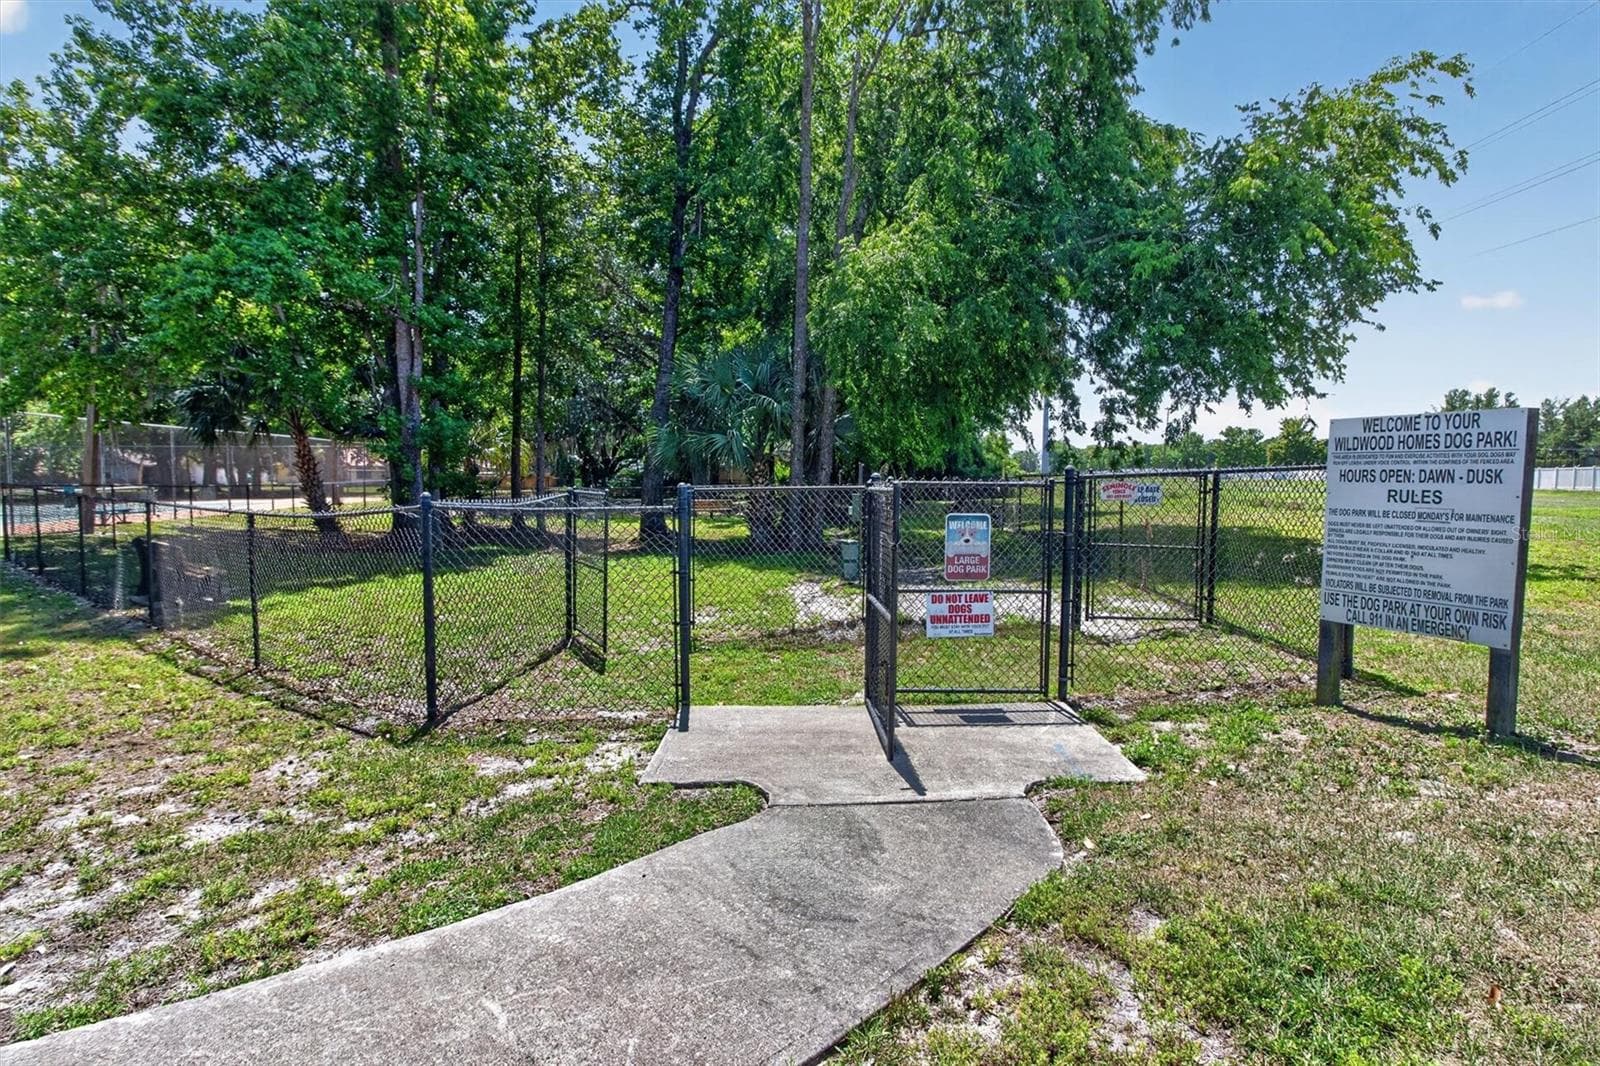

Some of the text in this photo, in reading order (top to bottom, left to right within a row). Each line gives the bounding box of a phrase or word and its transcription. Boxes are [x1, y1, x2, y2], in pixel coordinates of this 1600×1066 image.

[1362, 413, 1480, 432] WELCOME TO YOUR
[1334, 431, 1517, 450] WILDWOOD HOMES DOG PARK!
[1339, 470, 1376, 482] HOURS
[1380, 470, 1415, 482] OPEN:
[1419, 470, 1455, 483] DAWN
[1467, 470, 1503, 484] DUSK
[1388, 490, 1442, 504] RULES
[948, 520, 988, 530] WELCOME
[1465, 513, 1515, 523] MAINTENANCE
[954, 556, 980, 564] LARGE
[948, 565, 987, 574] DOG PARK
[932, 594, 989, 604] DO NOT LEAVE
[1326, 579, 1508, 608] VIOLATORS WILL BE SUBJECTED TO REMOVAL FROM THE PARK
[948, 604, 972, 614] DOGS
[1324, 592, 1507, 629] USE THE DOG PARK AT YOUR OWN RISK
[1346, 609, 1471, 640] CALL 911 IN AN EMERGENCY
